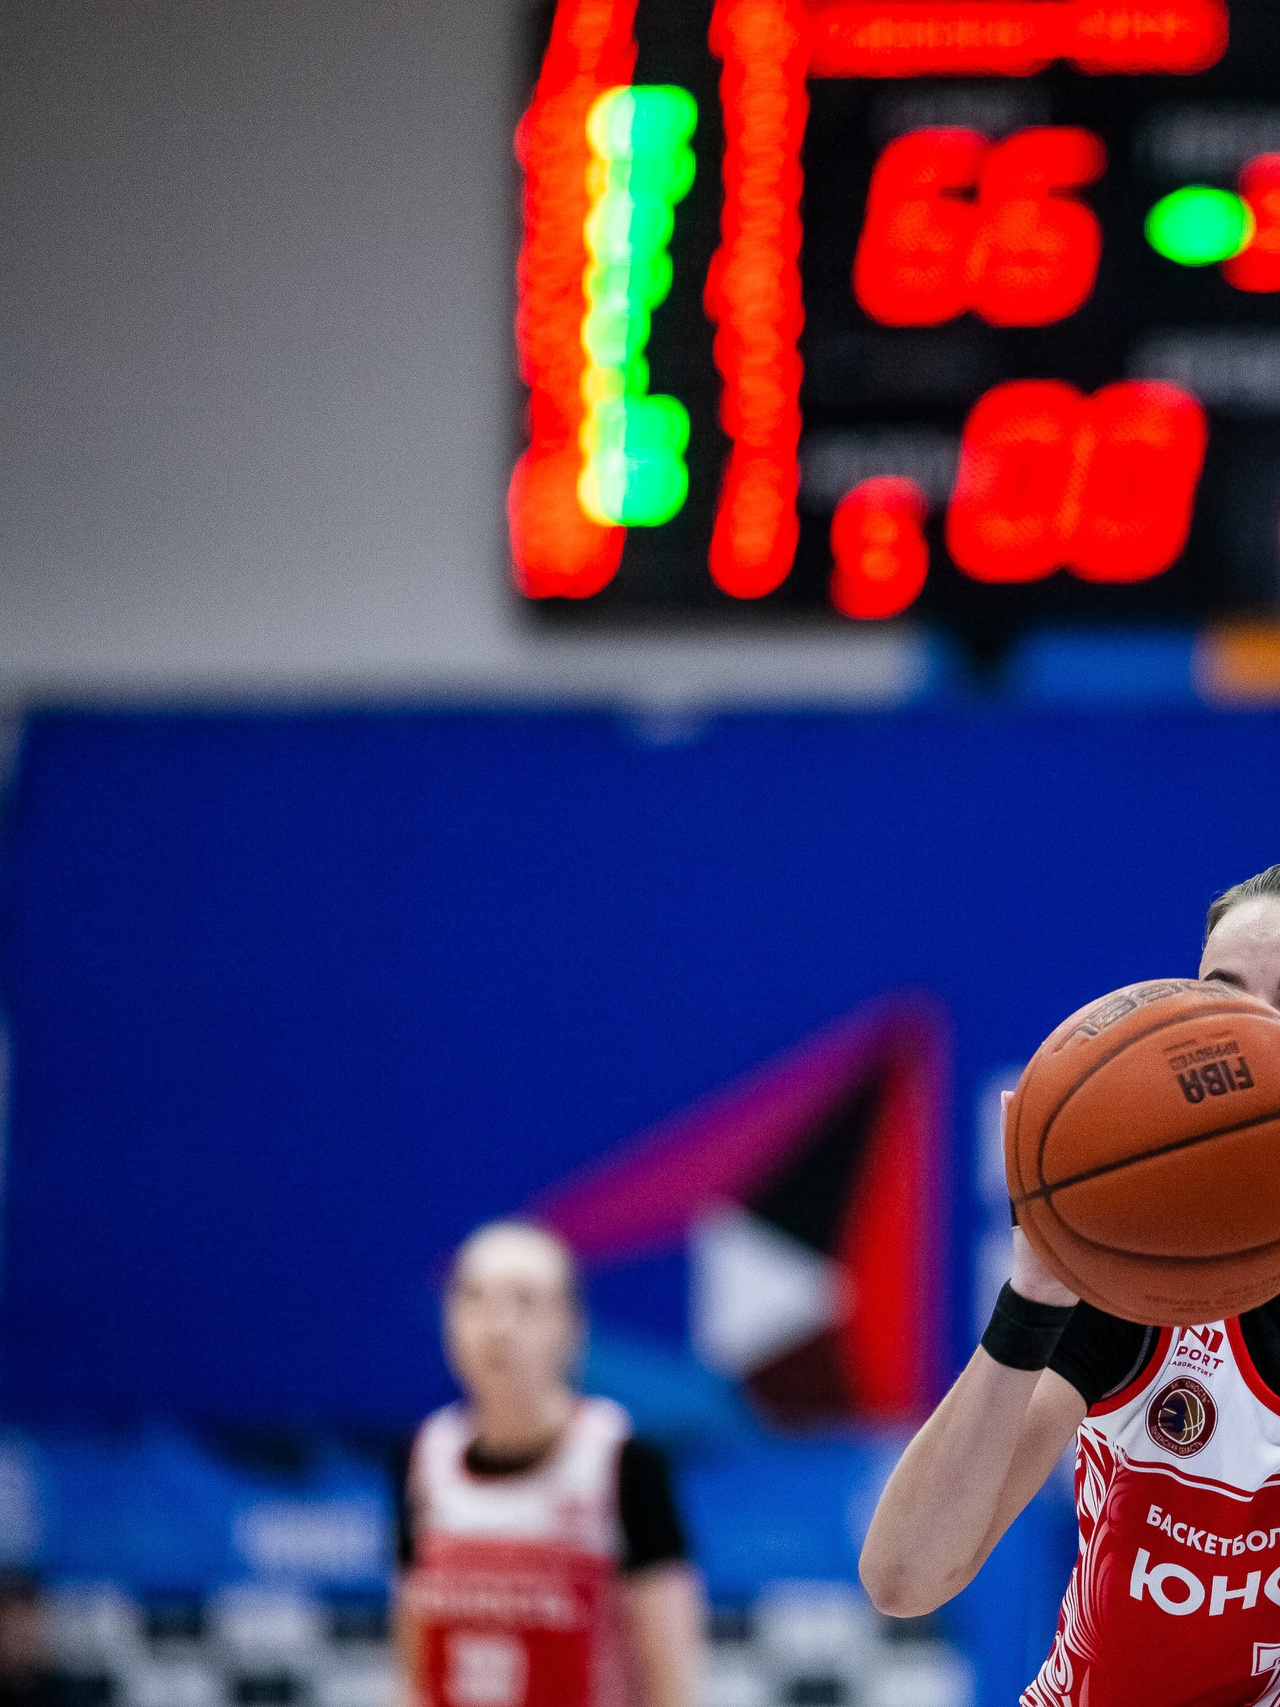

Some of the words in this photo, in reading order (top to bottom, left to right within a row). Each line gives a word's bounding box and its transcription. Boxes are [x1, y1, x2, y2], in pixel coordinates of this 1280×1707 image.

[853, 126, 1106, 327] 66
[1177, 1056, 1254, 1104] FIBA
[1168, 1360, 1213, 1378] ABORATORY
[1176, 1346, 1224, 1369] PORT
